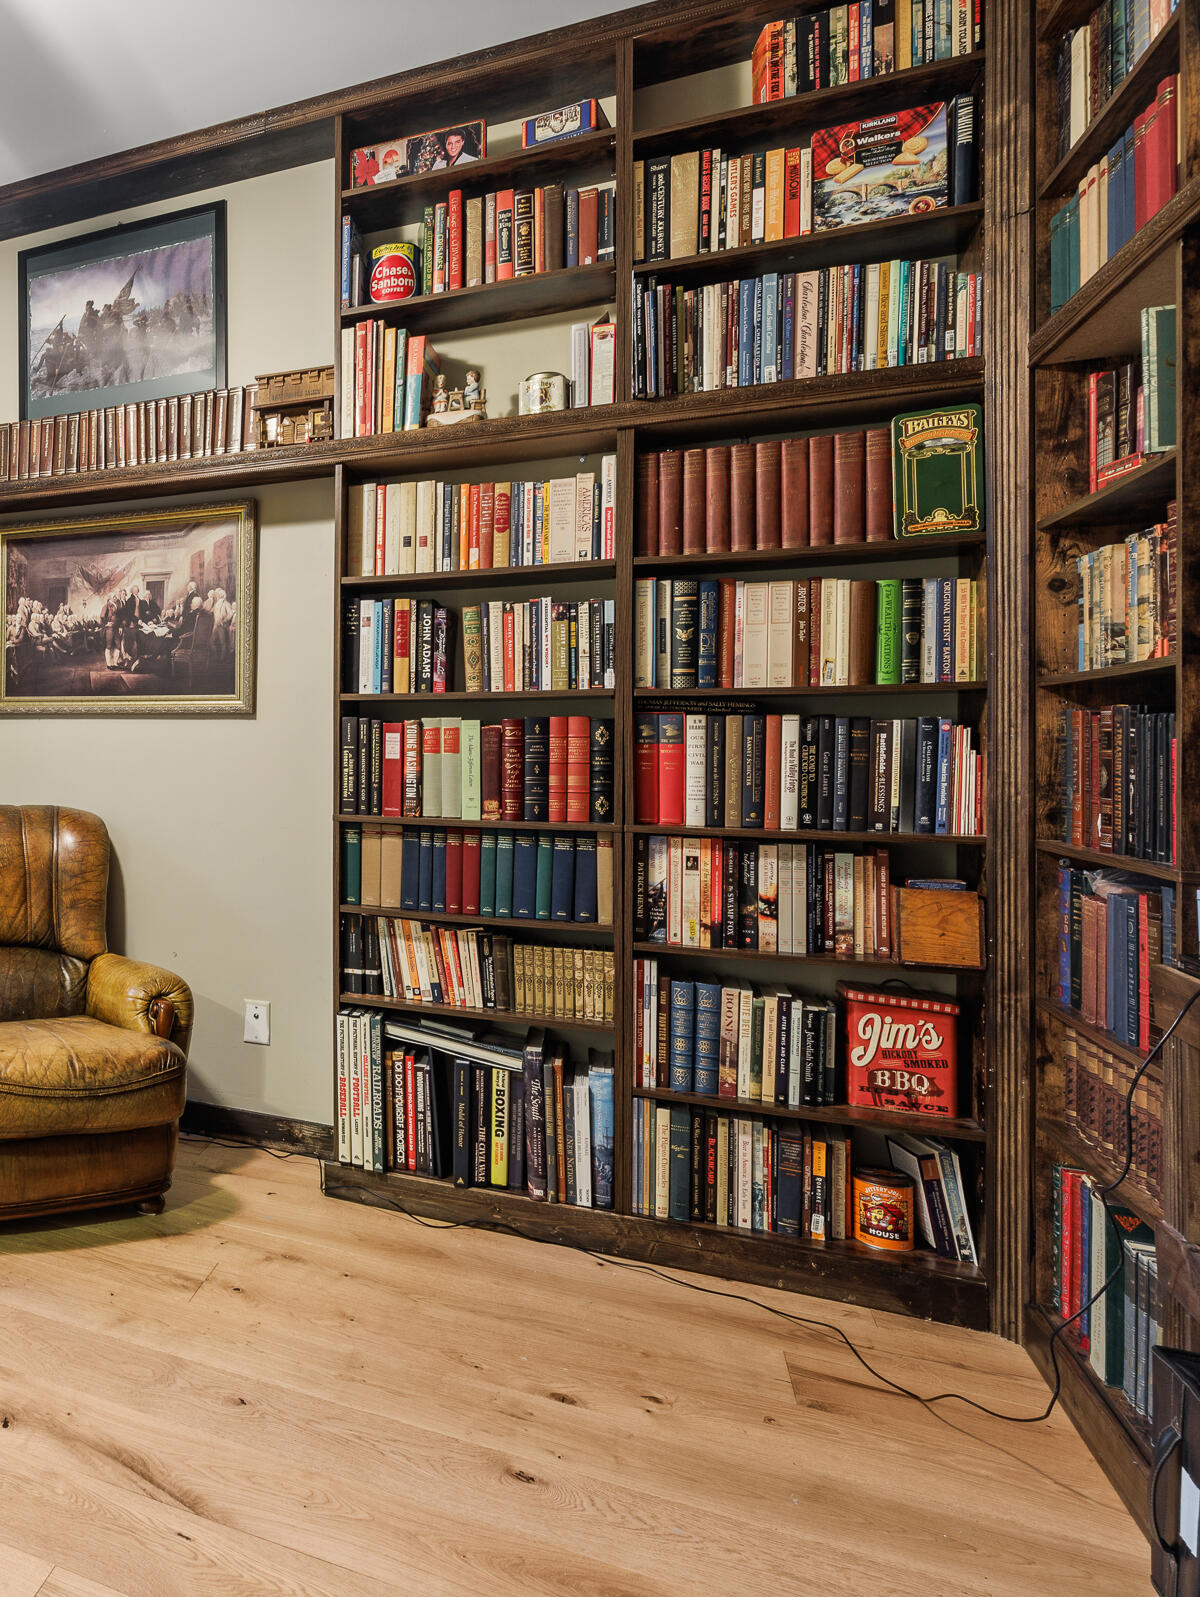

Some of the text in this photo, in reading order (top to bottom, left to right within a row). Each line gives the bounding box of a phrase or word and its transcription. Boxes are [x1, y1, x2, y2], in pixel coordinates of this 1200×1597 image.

[959, 10, 967, 55] JOHN TOLAND
[771, 81, 779, 92] FOX
[856, 130, 901, 146] Walkers
[862, 117, 896, 129] KIRKLAND
[650, 163, 668, 171] Shirer
[702, 152, 711, 211] HITLER'S SECRET BOOK
[789, 165, 800, 200] MUSSOLINI
[730, 159, 738, 218] HITLER'S GAMES
[372, 277, 413, 292] Sanborn
[375, 266, 408, 278] Chase
[766, 295, 774, 354] Colonial South Carolina
[801, 281, 813, 371] Charleston! Charleston!
[880, 294, 888, 348] Rice and Slaves
[901, 284, 909, 347] CHARLESTON GHOSTS
[906, 413, 970, 435] BAILEYS
[582, 488, 591, 532] AMERICA'S
[798, 585, 807, 612] ARATOR
[884, 589, 893, 598] The
[960, 605, 968, 613] The
[884, 599, 893, 632] WEALTH
[943, 581, 951, 673] ORIGINAL INTENT BARTON
[960, 615, 968, 624] Story
[423, 613, 431, 679] JOHN ADAMS
[884, 637, 893, 669] NATIONS
[960, 639, 968, 663] Constitution
[405, 724, 416, 798] YOUNG WASHINGTON
[878, 733, 887, 773] Battlefields
[787, 765, 798, 793] Valley Forge
[810, 773, 816, 781] TO
[940, 763, 948, 806] American Revolution
[725, 993, 734, 1035] BOONE
[741, 994, 750, 1038] WHITE DEVIL
[804, 1030, 814, 1082] Jedediah Smith
[850, 1013, 944, 1067] Jim's
[881, 1050, 918, 1060] HICKORY
[395, 1061, 404, 1073] 101
[873, 1070, 930, 1095] BBQ
[373, 1065, 383, 1129] RAILROADS
[495, 1088, 505, 1138] BOXING
[530, 1079, 542, 1120] The South
[395, 1130, 404, 1163] PROJECTS
[478, 1126, 486, 1182] THE CIVIL WAR
[708, 1137, 716, 1184] BLACKBEARD
[888, 1191, 903, 1200] JOE'S
[869, 1228, 900, 1240] HOUSE
